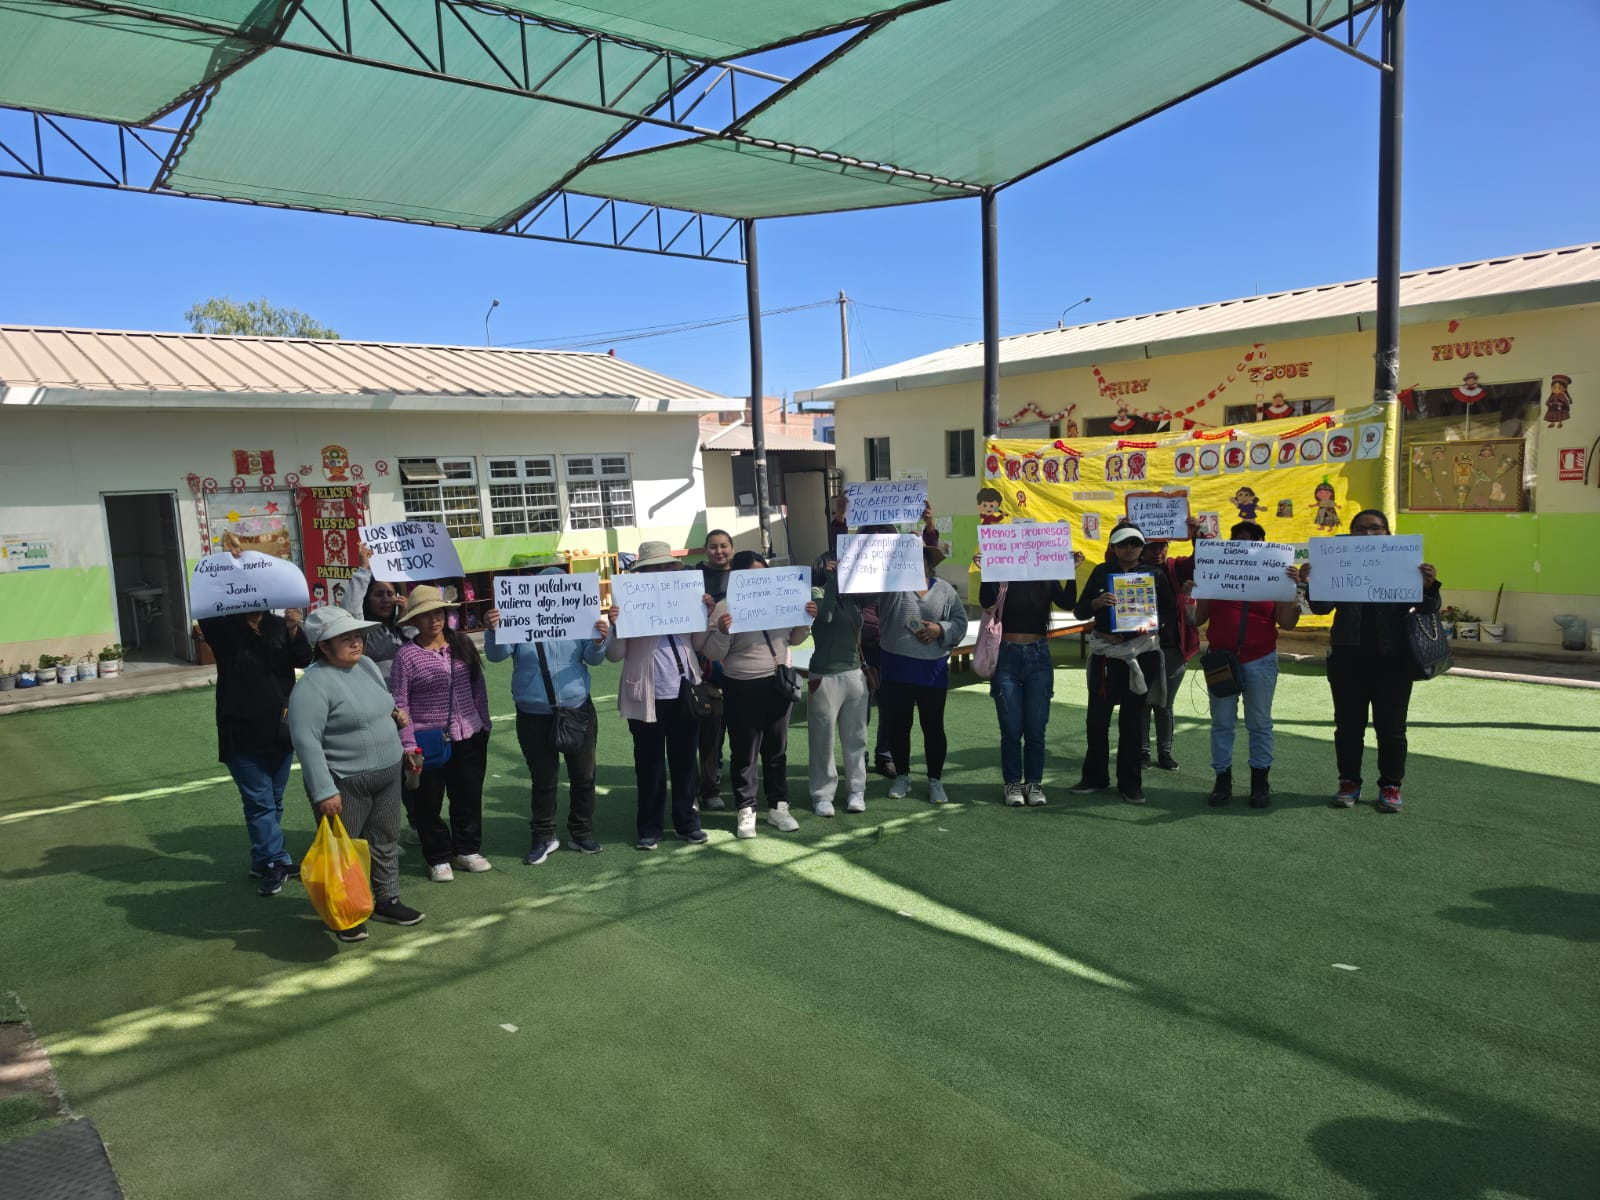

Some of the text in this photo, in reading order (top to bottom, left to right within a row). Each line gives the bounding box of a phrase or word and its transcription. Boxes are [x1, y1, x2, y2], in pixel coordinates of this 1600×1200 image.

[312, 487, 352, 499] FELICES
[848, 482, 920, 497] EL ALCALDE
[853, 495, 901, 507] ROBERTO
[873, 509, 899, 521] TIENE
[313, 517, 355, 530] FIESTAS
[364, 526, 388, 542] LOS
[392, 521, 423, 538] NIÑOS
[980, 526, 1069, 539] Menos promesas
[369, 536, 435, 555] MERECEN LO
[1010, 538, 1069, 553] presupuesto
[387, 552, 435, 572] MEJOR
[986, 555, 1015, 568] para
[1018, 551, 1029, 565] el
[1339, 560, 1353, 568] DE
[500, 579, 512, 596] Si
[534, 578, 582, 597] palabra
[622, 581, 656, 596] BASTA
[660, 582, 671, 592] DE
[1331, 573, 1371, 590] NIÑOS
[497, 597, 532, 610] valiera
[562, 596, 580, 609] hoy
[583, 594, 598, 607] los
[666, 600, 678, 609] SU
[498, 614, 531, 628] niños
